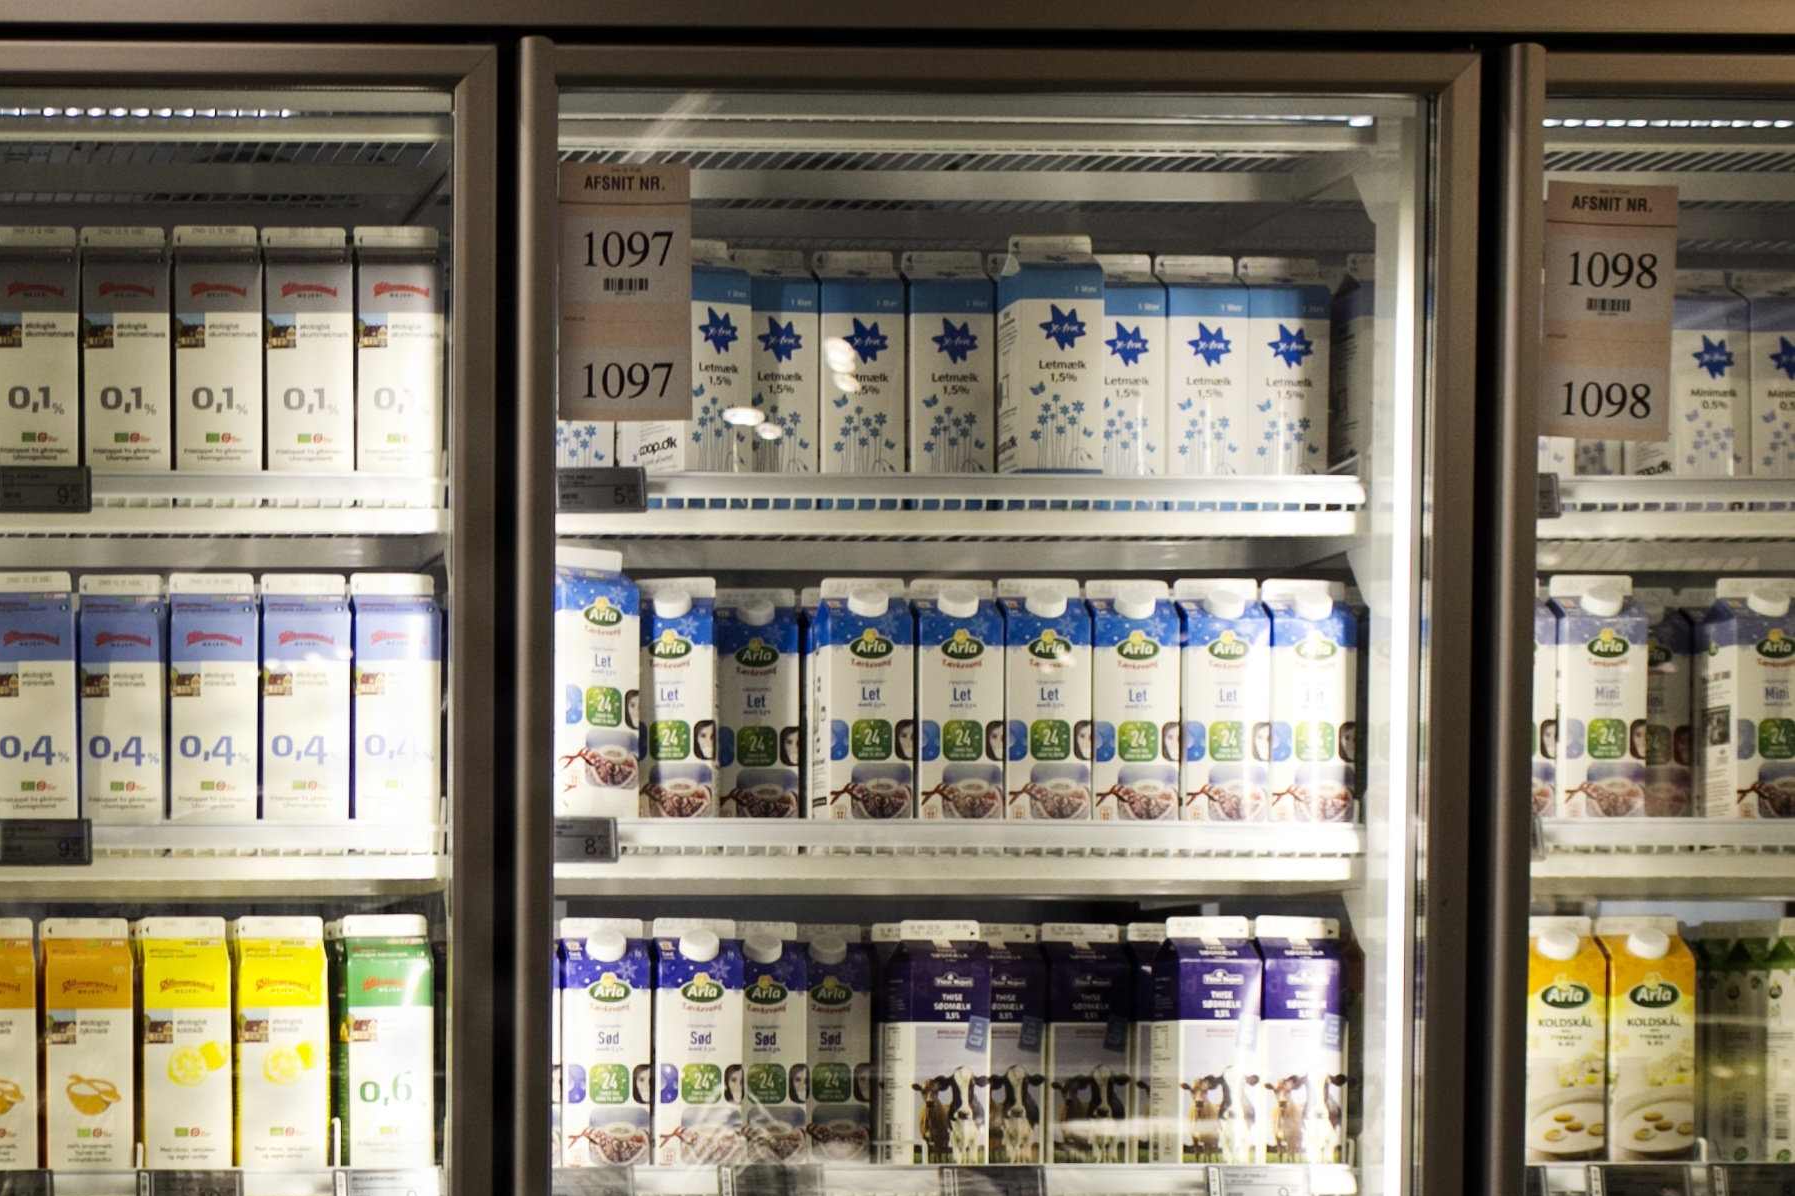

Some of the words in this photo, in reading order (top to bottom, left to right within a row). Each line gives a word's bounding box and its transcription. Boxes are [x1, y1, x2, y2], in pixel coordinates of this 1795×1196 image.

[584, 175, 634, 191] AFSNIT
[639, 175, 665, 191] NR.
[1572, 196, 1622, 212] AFSNIT
[1626, 198, 1652, 213] NR.
[583, 231, 673, 267] 1097
[1569, 251, 1658, 289] 1098
[699, 362, 739, 374] Letmælk
[1038, 359, 1087, 370] Letmælk
[583, 362, 673, 399] 1097
[709, 375, 732, 386] 1,5%
[757, 371, 803, 382] Letmælk
[931, 372, 978, 383] Letmælk
[1050, 372, 1077, 383] 1,5%
[1104, 376, 1150, 387] Letmælk
[1186, 376, 1232, 387] Letmælk
[1265, 377, 1314, 388] Letmælk
[768, 384, 794, 394] 1,5%
[942, 385, 969, 396] 1,5%
[1115, 388, 1141, 399] 1,5%
[1197, 388, 1223, 399] 1,5%
[1690, 388, 1737, 397] Minimælk
[8, 386, 65, 416] 0,1%
[100, 386, 156, 416] 0,1%
[191, 386, 248, 415] 0,1%
[1562, 381, 1651, 418] 1098
[589, 610, 617, 622] Arla
[655, 642, 685, 655] Arla
[856, 641, 887, 652] Arla
[947, 642, 977, 653] Arla
[1123, 643, 1153, 655] Arla
[595, 654, 611, 668] Let
[742, 650, 771, 662] Arla
[660, 688, 679, 701] Let
[862, 687, 880, 700] Let
[954, 688, 971, 701] Let
[1040, 688, 1059, 700] Let
[1129, 690, 1147, 701] Let
[1595, 686, 1620, 699] Mini
[1765, 687, 1789, 699] Mini
[597, 697, 611, 711] 24
[747, 696, 765, 708] Let
[662, 731, 678, 746] 24
[865, 729, 880, 745] 24
[956, 730, 970, 746] 24
[1043, 729, 1058, 745] 24
[1131, 730, 1146, 746] 24
[0, 735, 70, 767] 0,4%
[88, 735, 160, 767] 0,4%
[179, 734, 250, 766] 0,4%
[594, 986, 625, 999] Arla
[687, 986, 718, 999] Arla
[752, 988, 781, 1000] Arla
[818, 988, 846, 1000] Arla
[1211, 991, 1233, 999] THISE
[1547, 990, 1584, 1003] Arla
[1636, 989, 1672, 1002] Arla
[934, 1002, 972, 1010] SØDMÆLK
[1202, 1000, 1242, 1009] SØDMÆLK
[1538, 1015, 1593, 1028] KOLDSKÅL
[1627, 1014, 1682, 1027] KOLDSKÅL
[598, 1032, 620, 1045] Sød
[690, 1032, 712, 1045] Sød
[755, 1032, 776, 1046] Sød
[820, 1032, 841, 1045] Sød
[602, 1075, 618, 1089] 24
[759, 1074, 775, 1088] 24
[824, 1073, 839, 1087] 24
